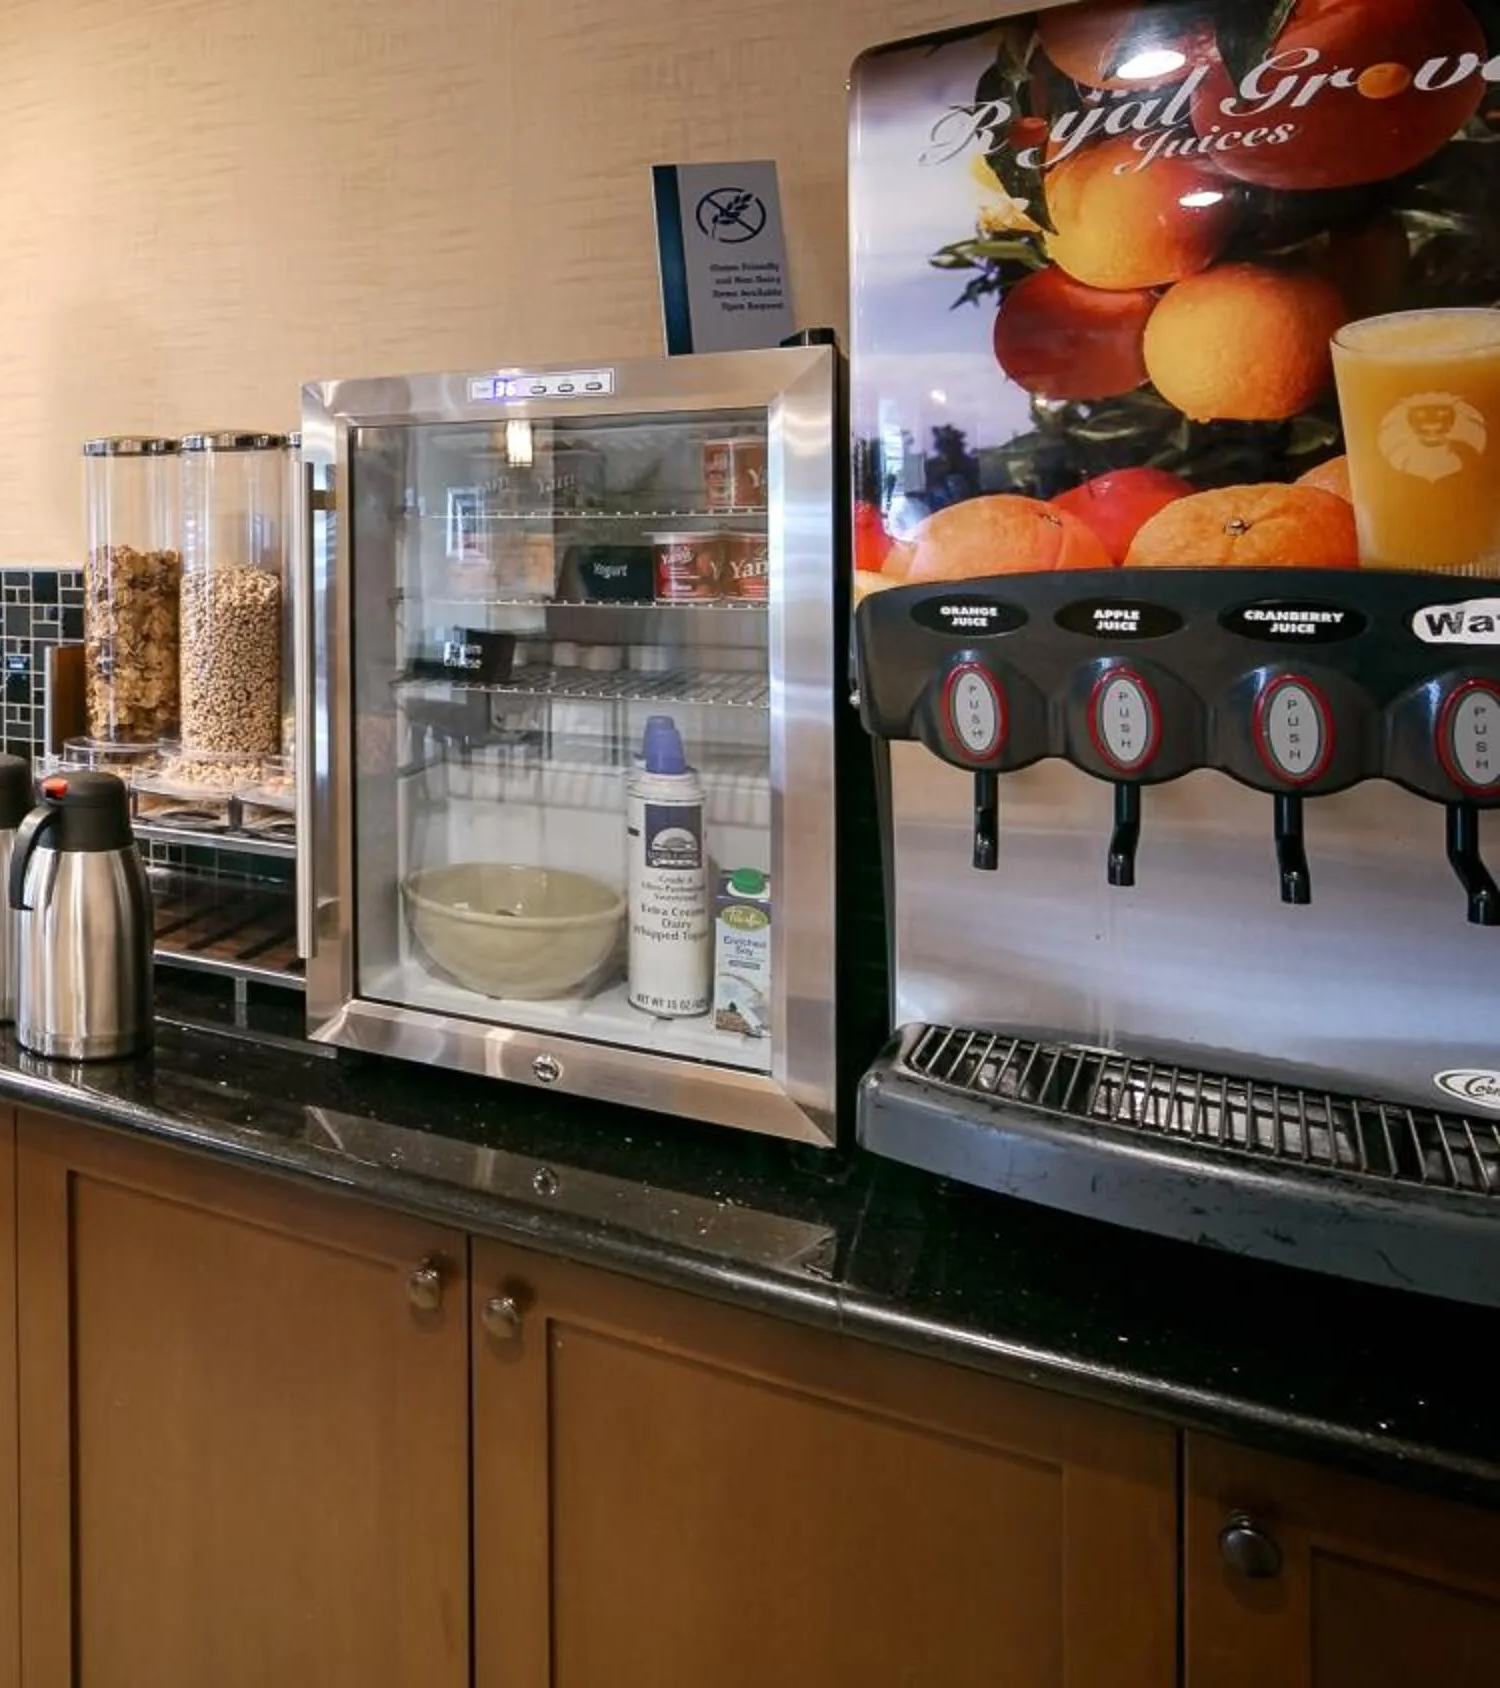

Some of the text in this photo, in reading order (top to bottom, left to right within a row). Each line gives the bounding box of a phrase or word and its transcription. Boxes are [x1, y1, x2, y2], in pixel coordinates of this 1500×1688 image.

[1113, 120, 1295, 176] Juices
[593, 563, 628, 578] Yogurt
[939, 605, 998, 617] ORANGE
[1093, 608, 1140, 620] APPLE
[1244, 609, 1344, 623] CRANBERRY
[951, 616, 988, 627] JUICE
[1096, 620, 1138, 632] JUICE
[1424, 610, 1500, 637] Wa
[1269, 623, 1316, 634] JUICE
